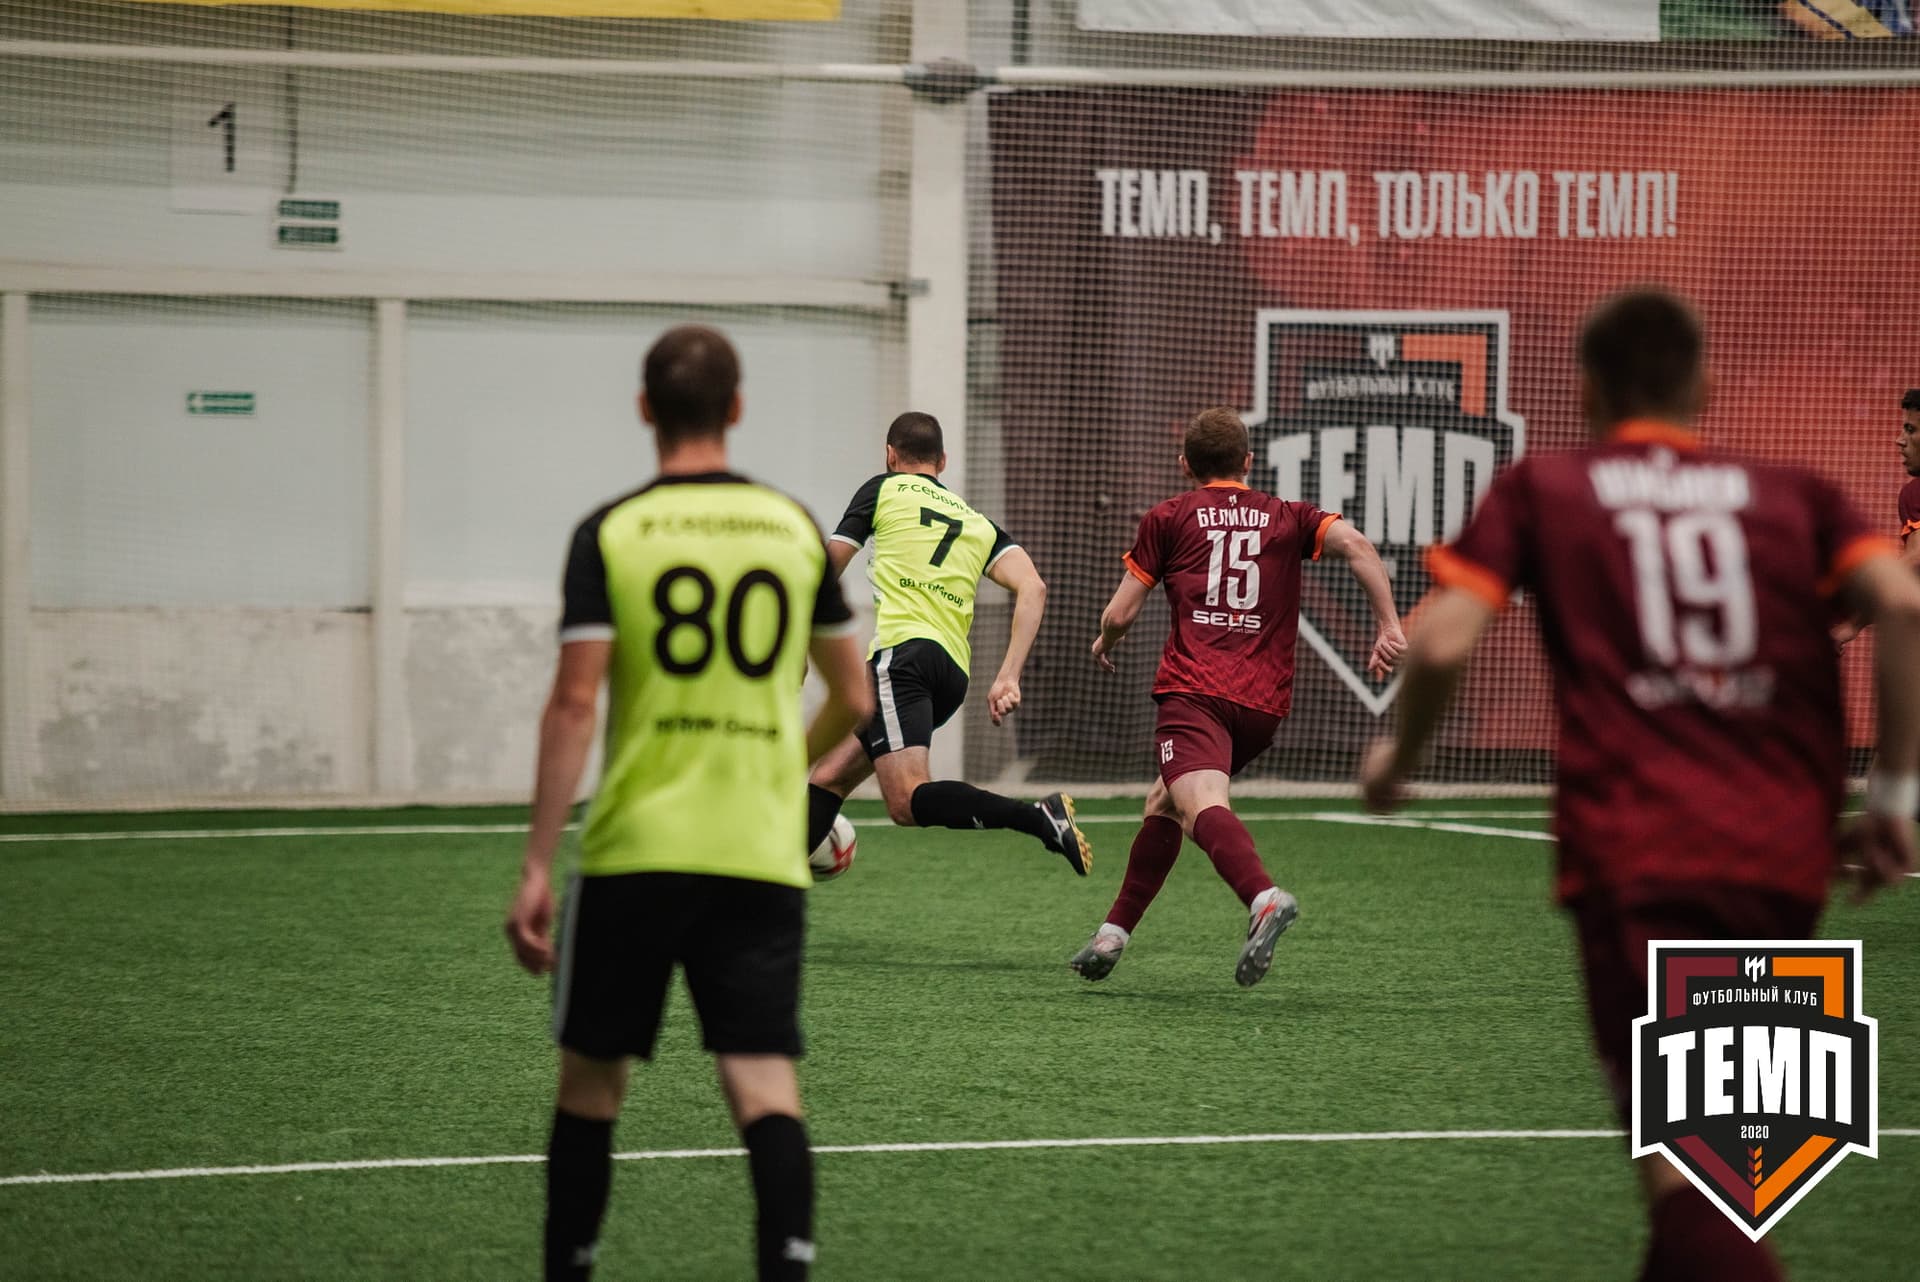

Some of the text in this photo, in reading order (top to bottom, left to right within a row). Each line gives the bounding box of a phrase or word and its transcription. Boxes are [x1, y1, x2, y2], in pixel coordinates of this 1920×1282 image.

[207, 102, 236, 173] 1
[1098, 168, 1679, 246] ТЕМП, ТЕМП, ТОЛЬКО ТЕМП!
[920, 506, 963, 568] 7
[1205, 530, 1261, 610] 15
[653, 566, 789, 679] 80
[1192, 610, 1262, 629] SEUS
[1614, 508, 1759, 665] 19
[1160, 739, 1174, 764] 15
